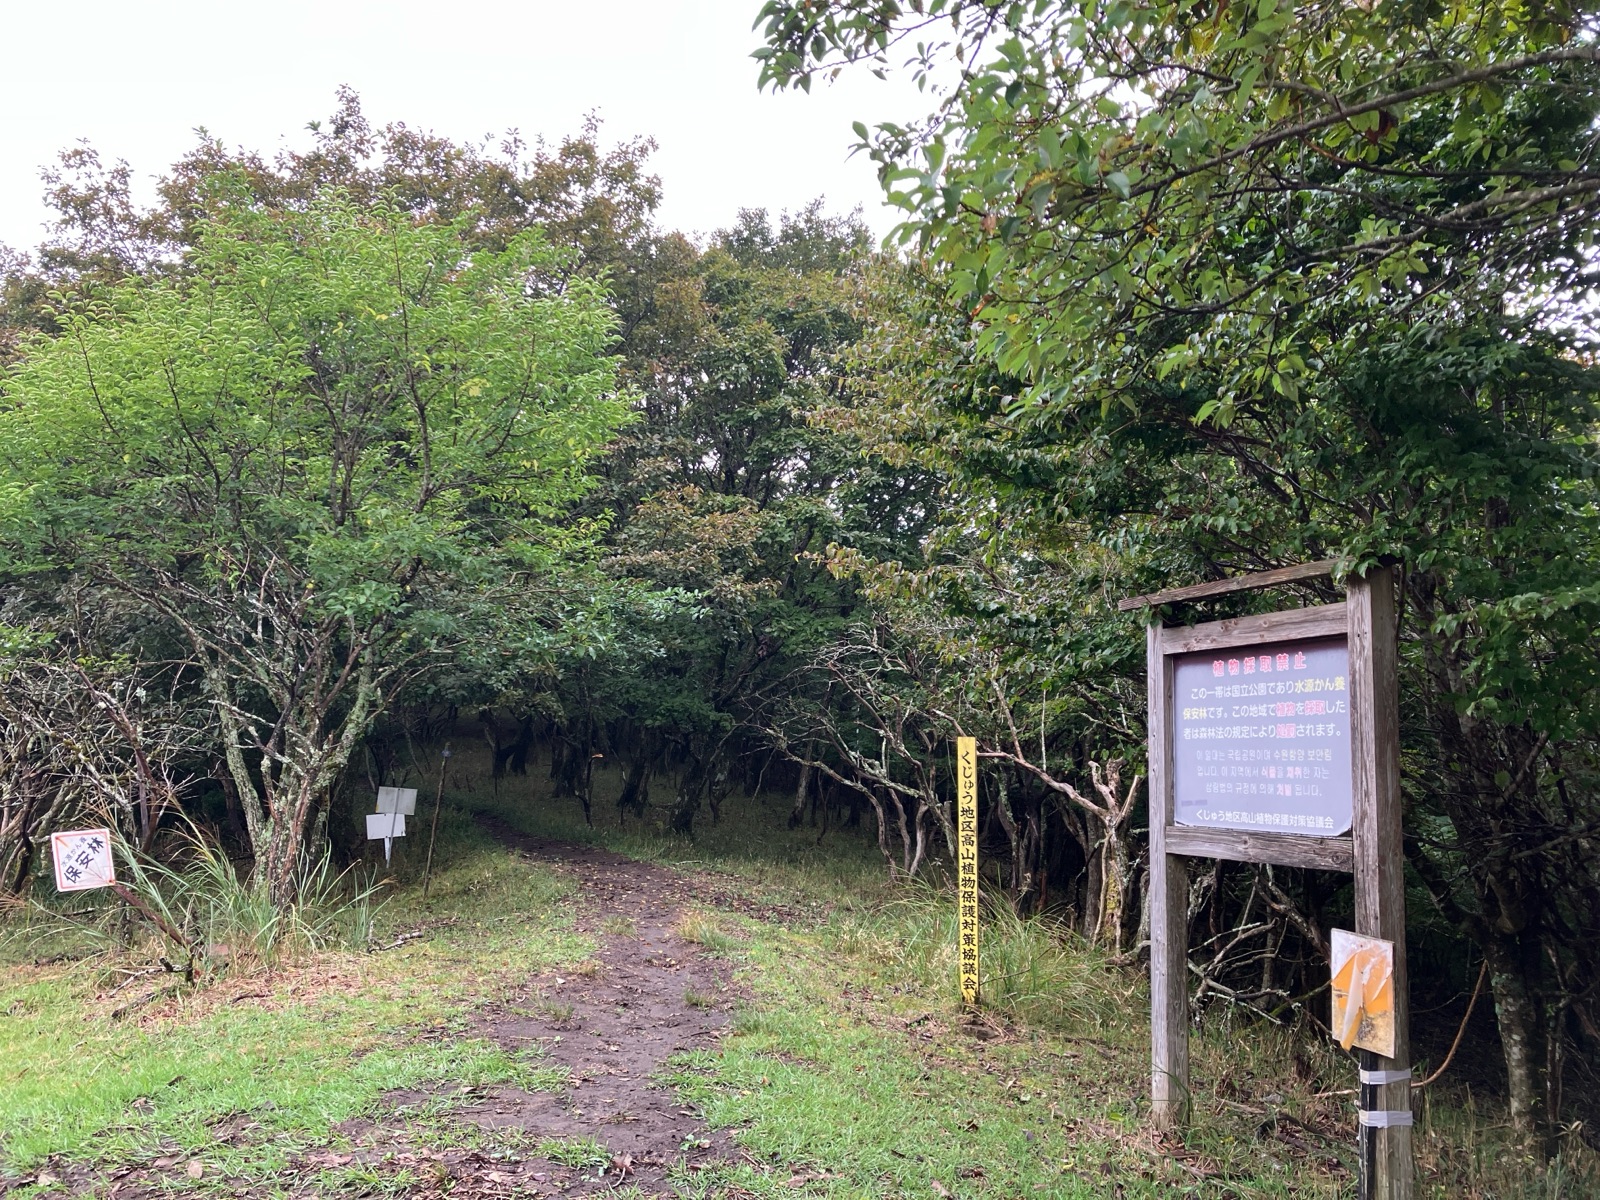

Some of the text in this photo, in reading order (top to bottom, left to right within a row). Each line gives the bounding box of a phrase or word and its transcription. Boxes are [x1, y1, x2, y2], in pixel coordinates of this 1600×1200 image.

[1212, 651, 1307, 677] 植物採取禁止
[64, 837, 104, 884] 保安林
[960, 751, 977, 990] くじゅう地区高山植物保護対策協議会
